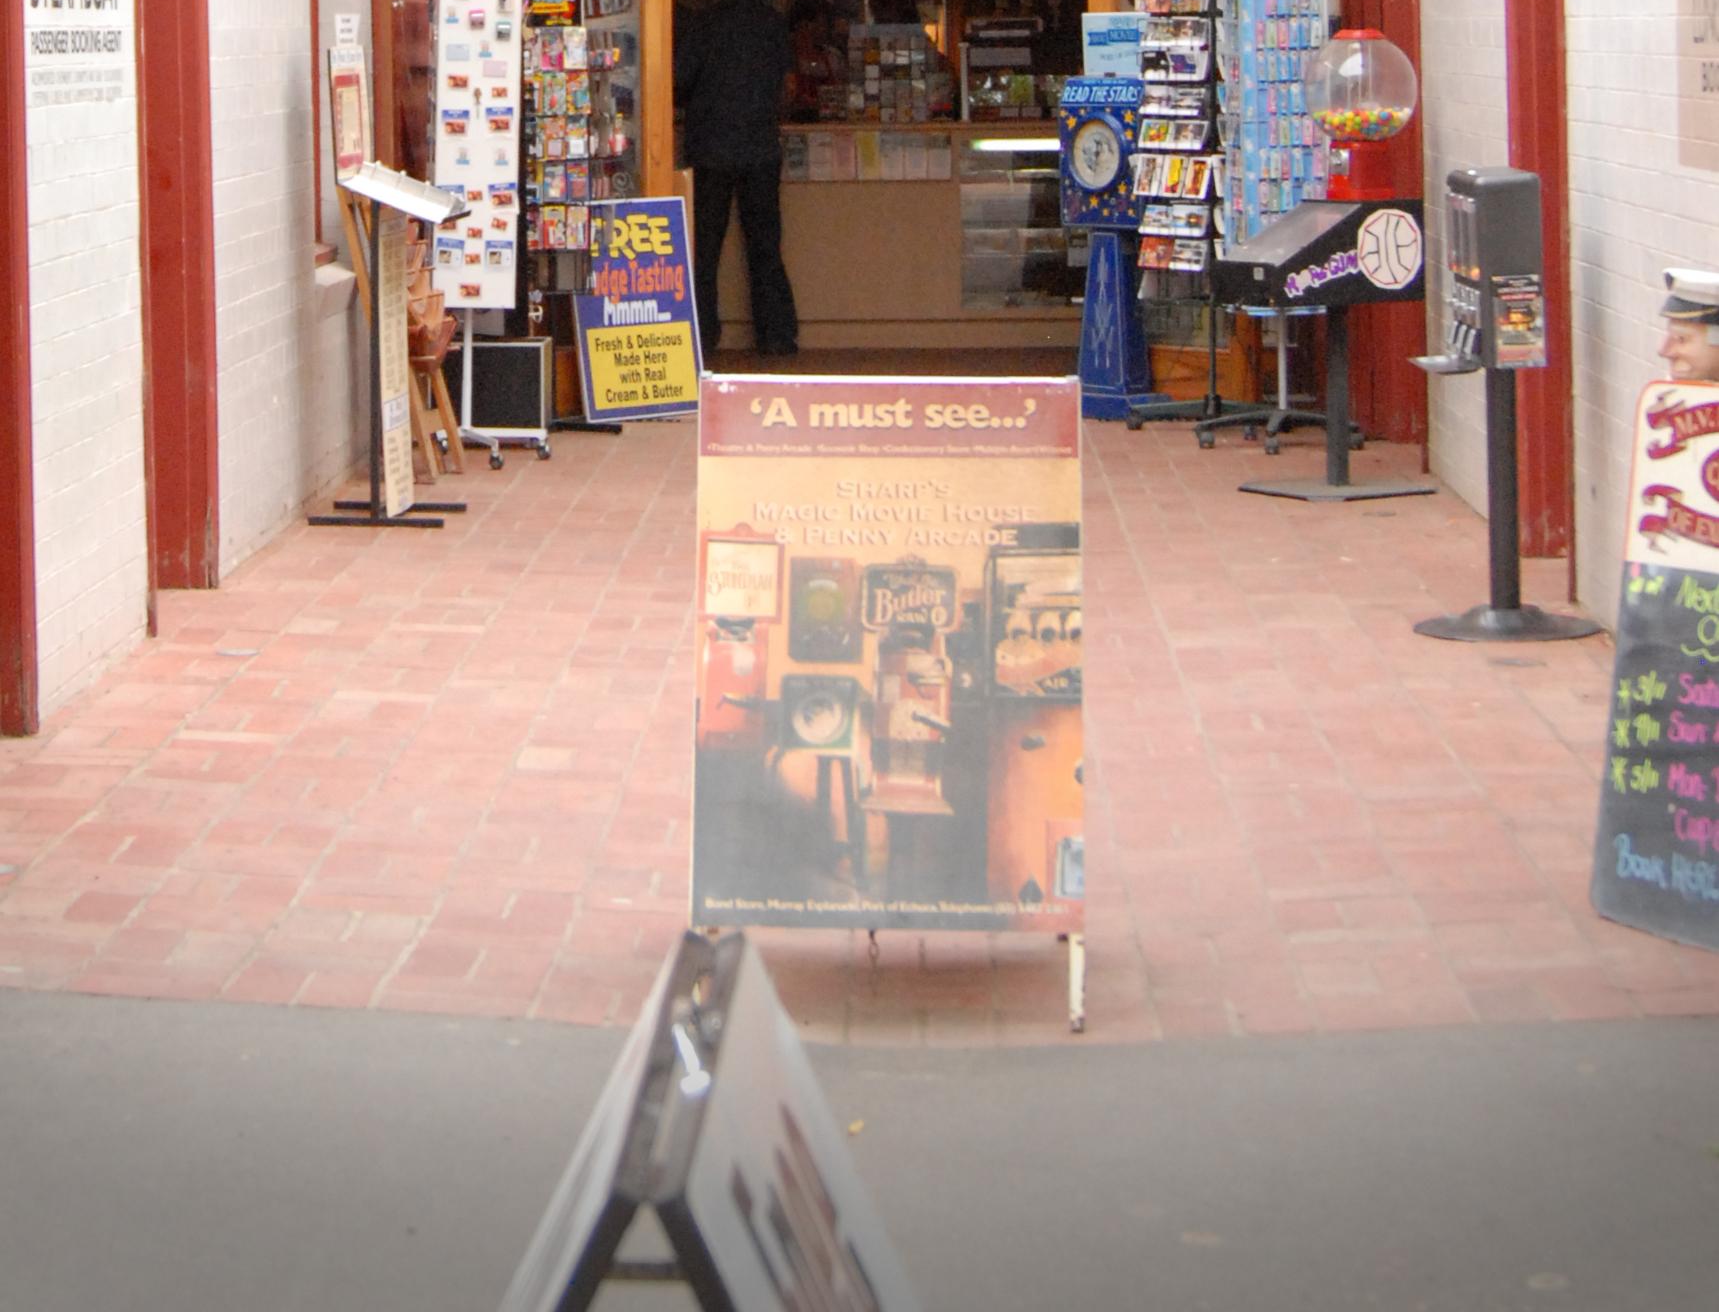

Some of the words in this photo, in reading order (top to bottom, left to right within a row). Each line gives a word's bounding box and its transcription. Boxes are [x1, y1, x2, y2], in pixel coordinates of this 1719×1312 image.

[1061, 85, 1089, 103] READ
[1089, 85, 1110, 103] THE
[629, 255, 686, 302] Tasting
[595, 336, 623, 352] Fresh
[626, 335, 634, 350] &
[637, 333, 683, 349] Delicious
[613, 352, 641, 367] Made
[644, 350, 668, 365] Here
[619, 370, 641, 384] with
[644, 367, 667, 382] Real
[606, 387, 639, 403] Cream
[642, 385, 650, 400] &
[653, 383, 684, 399] Butter
[808, 397, 913, 429] must
[836, 479, 952, 501] SHARP'S
[753, 500, 838, 522] MAGIC
[850, 501, 934, 523] MOVIE
[942, 502, 1036, 523] HOUSE
[774, 526, 793, 545] &
[803, 526, 893, 546] PENNY
[907, 528, 1019, 547] ARCADE
[874, 584, 947, 625] Butler
